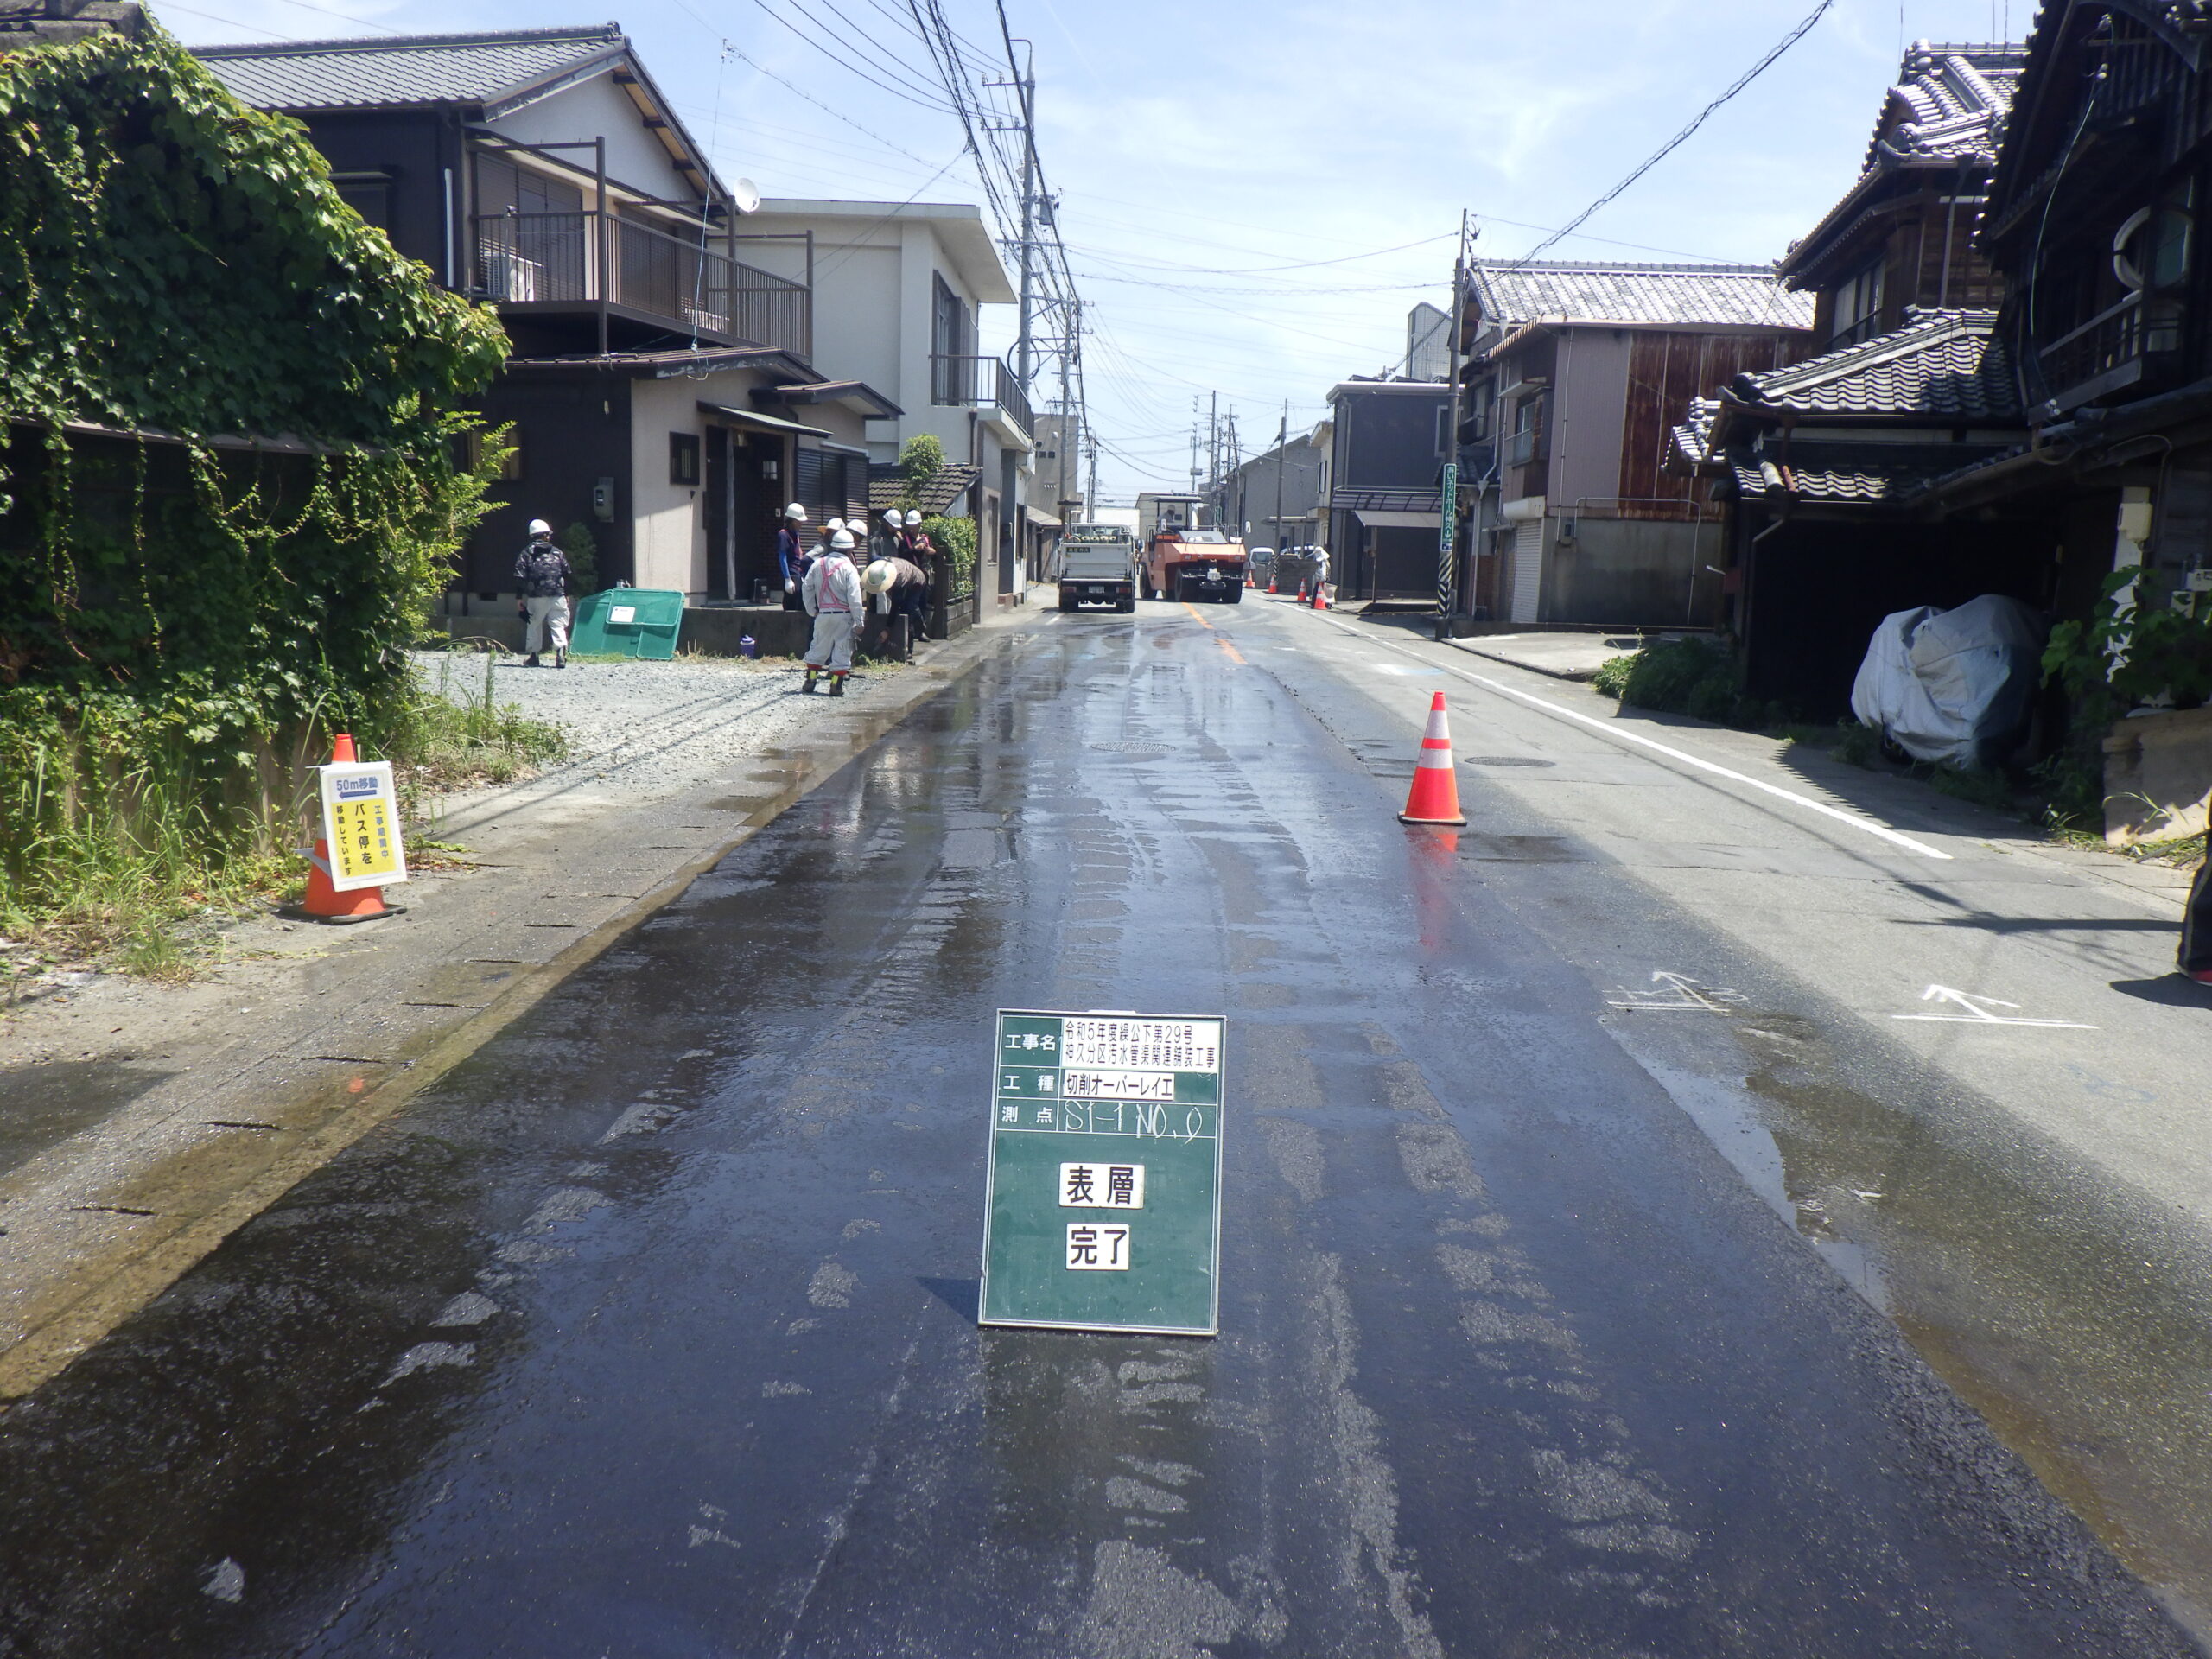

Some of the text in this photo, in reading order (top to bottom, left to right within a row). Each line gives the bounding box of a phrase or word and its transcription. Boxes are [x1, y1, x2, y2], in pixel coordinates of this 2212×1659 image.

[336, 777, 378, 791] 50m移動
[336, 805, 352, 876] 移動しています
[354, 804, 372, 865] バス停を
[374, 804, 389, 859] 工事期間中
[1004, 1033, 1056, 1051] 工事名
[1066, 1073, 1173, 1096] 切削オーバーレイ工
[1066, 1166, 1135, 1205] 表層
[1071, 1226, 1128, 1265] 完了
